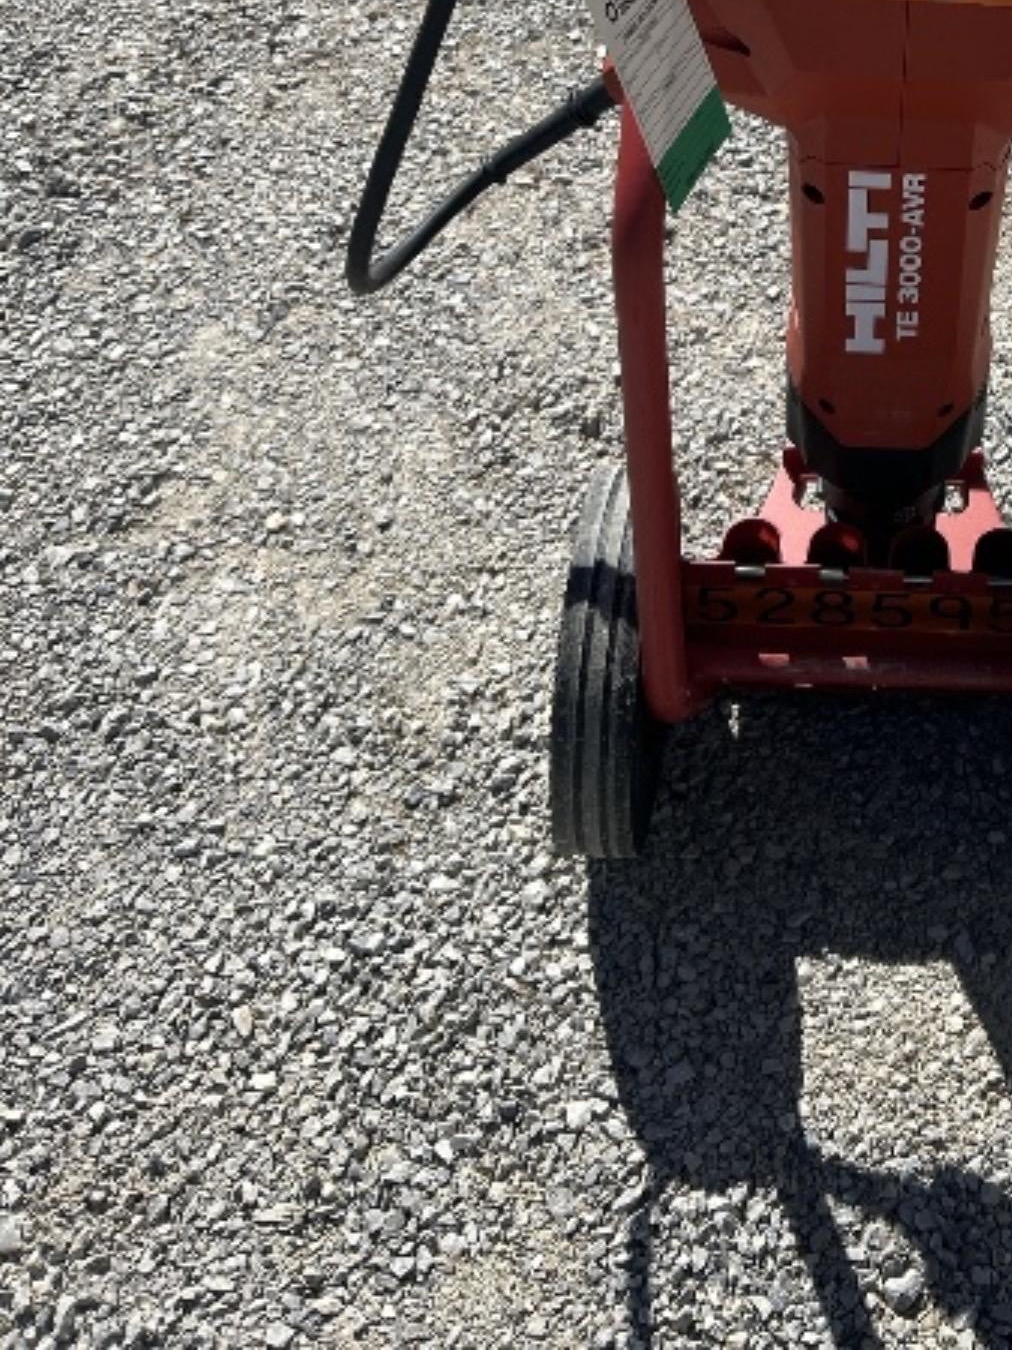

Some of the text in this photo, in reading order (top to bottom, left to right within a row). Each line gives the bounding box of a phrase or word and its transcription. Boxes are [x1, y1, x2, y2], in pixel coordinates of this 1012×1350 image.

[846, 171, 891, 354] HILTI
[896, 173, 926, 341] TE 3000-AVR
